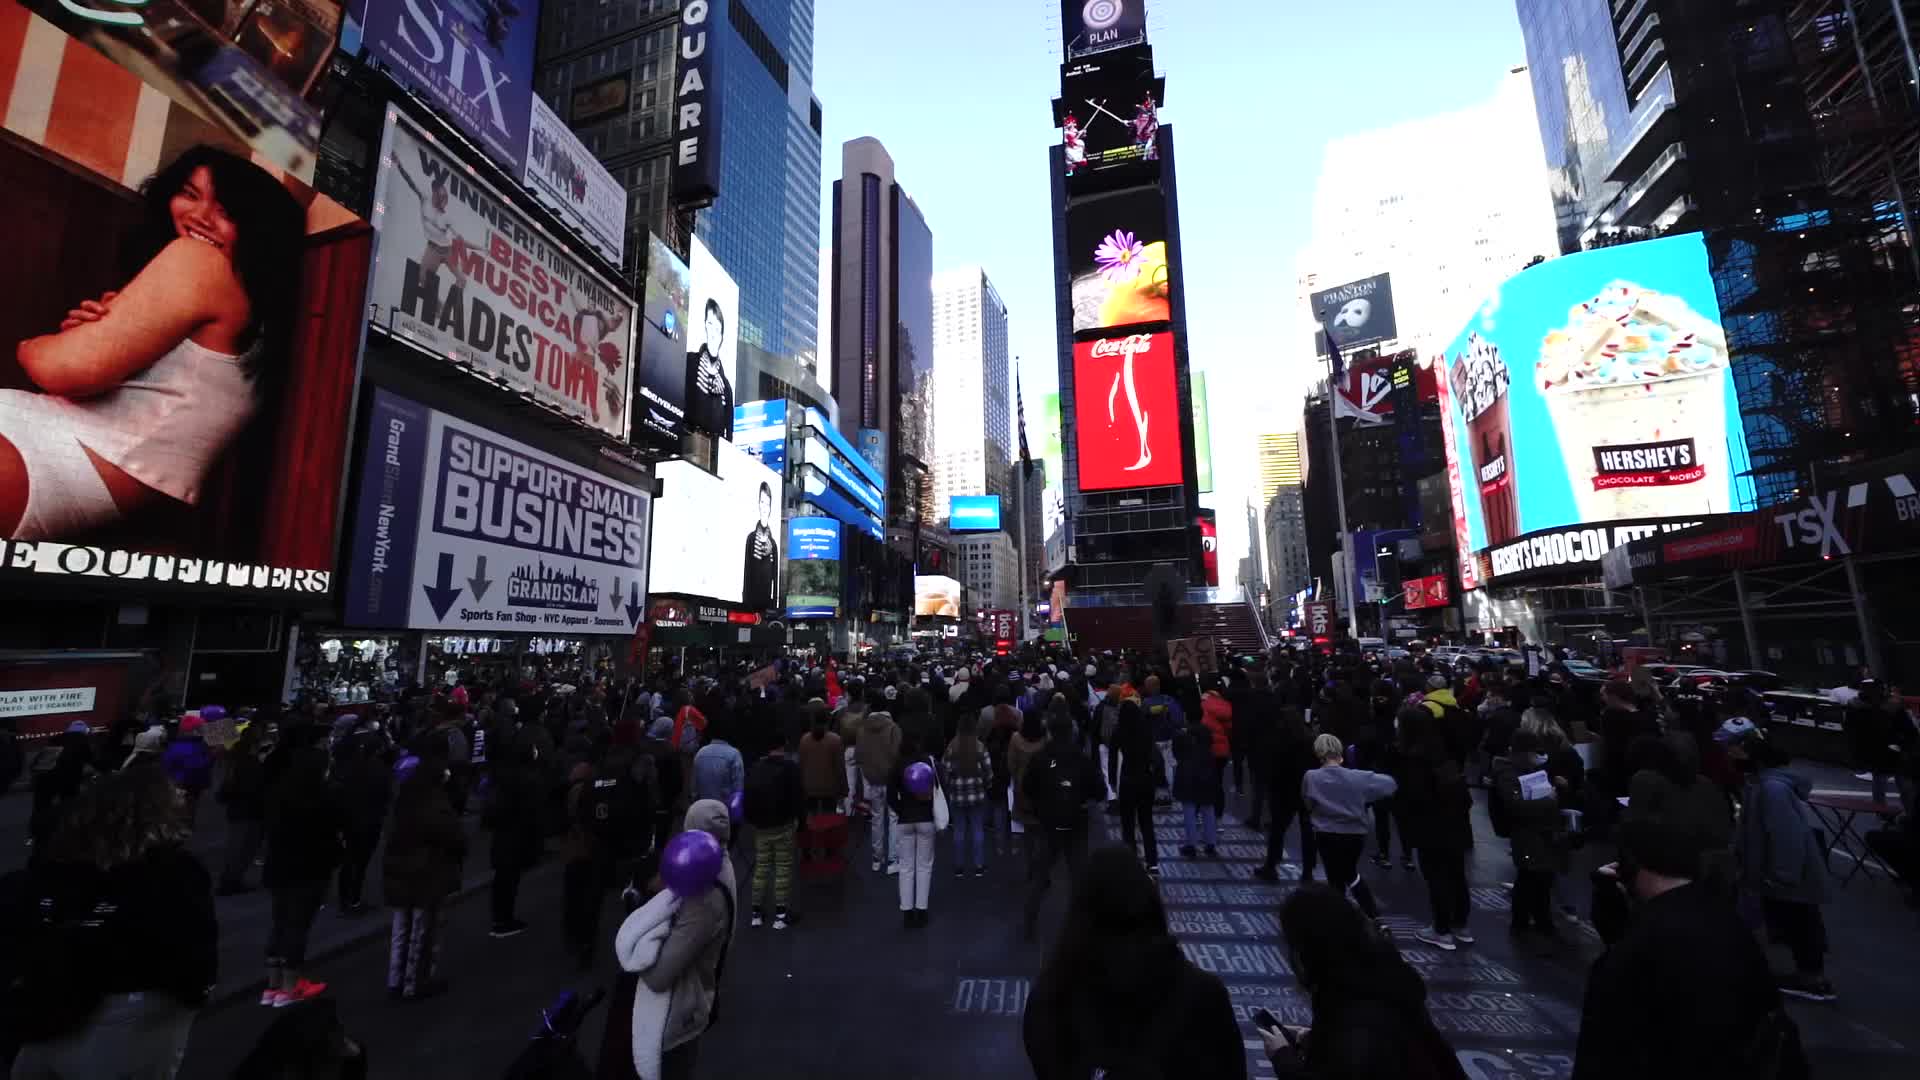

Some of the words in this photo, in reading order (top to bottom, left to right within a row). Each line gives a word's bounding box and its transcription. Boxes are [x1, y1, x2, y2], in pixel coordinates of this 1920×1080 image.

[397, 0, 512, 138] SIX
[1089, 29, 1118, 45] PLAN
[678, 0, 709, 167] QUARE
[418, 148, 536, 257] WINNER!
[546, 249, 575, 286] TONY
[576, 274, 616, 316] AWARDS
[449, 237, 588, 352] MUSICAL
[490, 230, 567, 305] BEST
[1323, 280, 1377, 303] PHANTOM
[450, 435, 577, 503] SUPPORT
[579, 480, 642, 523] SMALL
[1597, 475, 1655, 486] CHOCOLATE
[1669, 470, 1703, 482] WORLD
[1600, 444, 1692, 471] HERSHEY'S
[442, 471, 642, 566] BUSINESS
[1774, 490, 1852, 559] TSX
[508, 577, 562, 602] GRAND
[562, 583, 598, 605] SLAM
[1491, 540, 1533, 577] HERSHEY'S
[460, 608, 494, 622] Sports
[496, 611, 512, 621] Fan
[514, 611, 537, 624] Shop
[544, 613, 559, 624] NYC
[561, 615, 589, 627] Apparel
